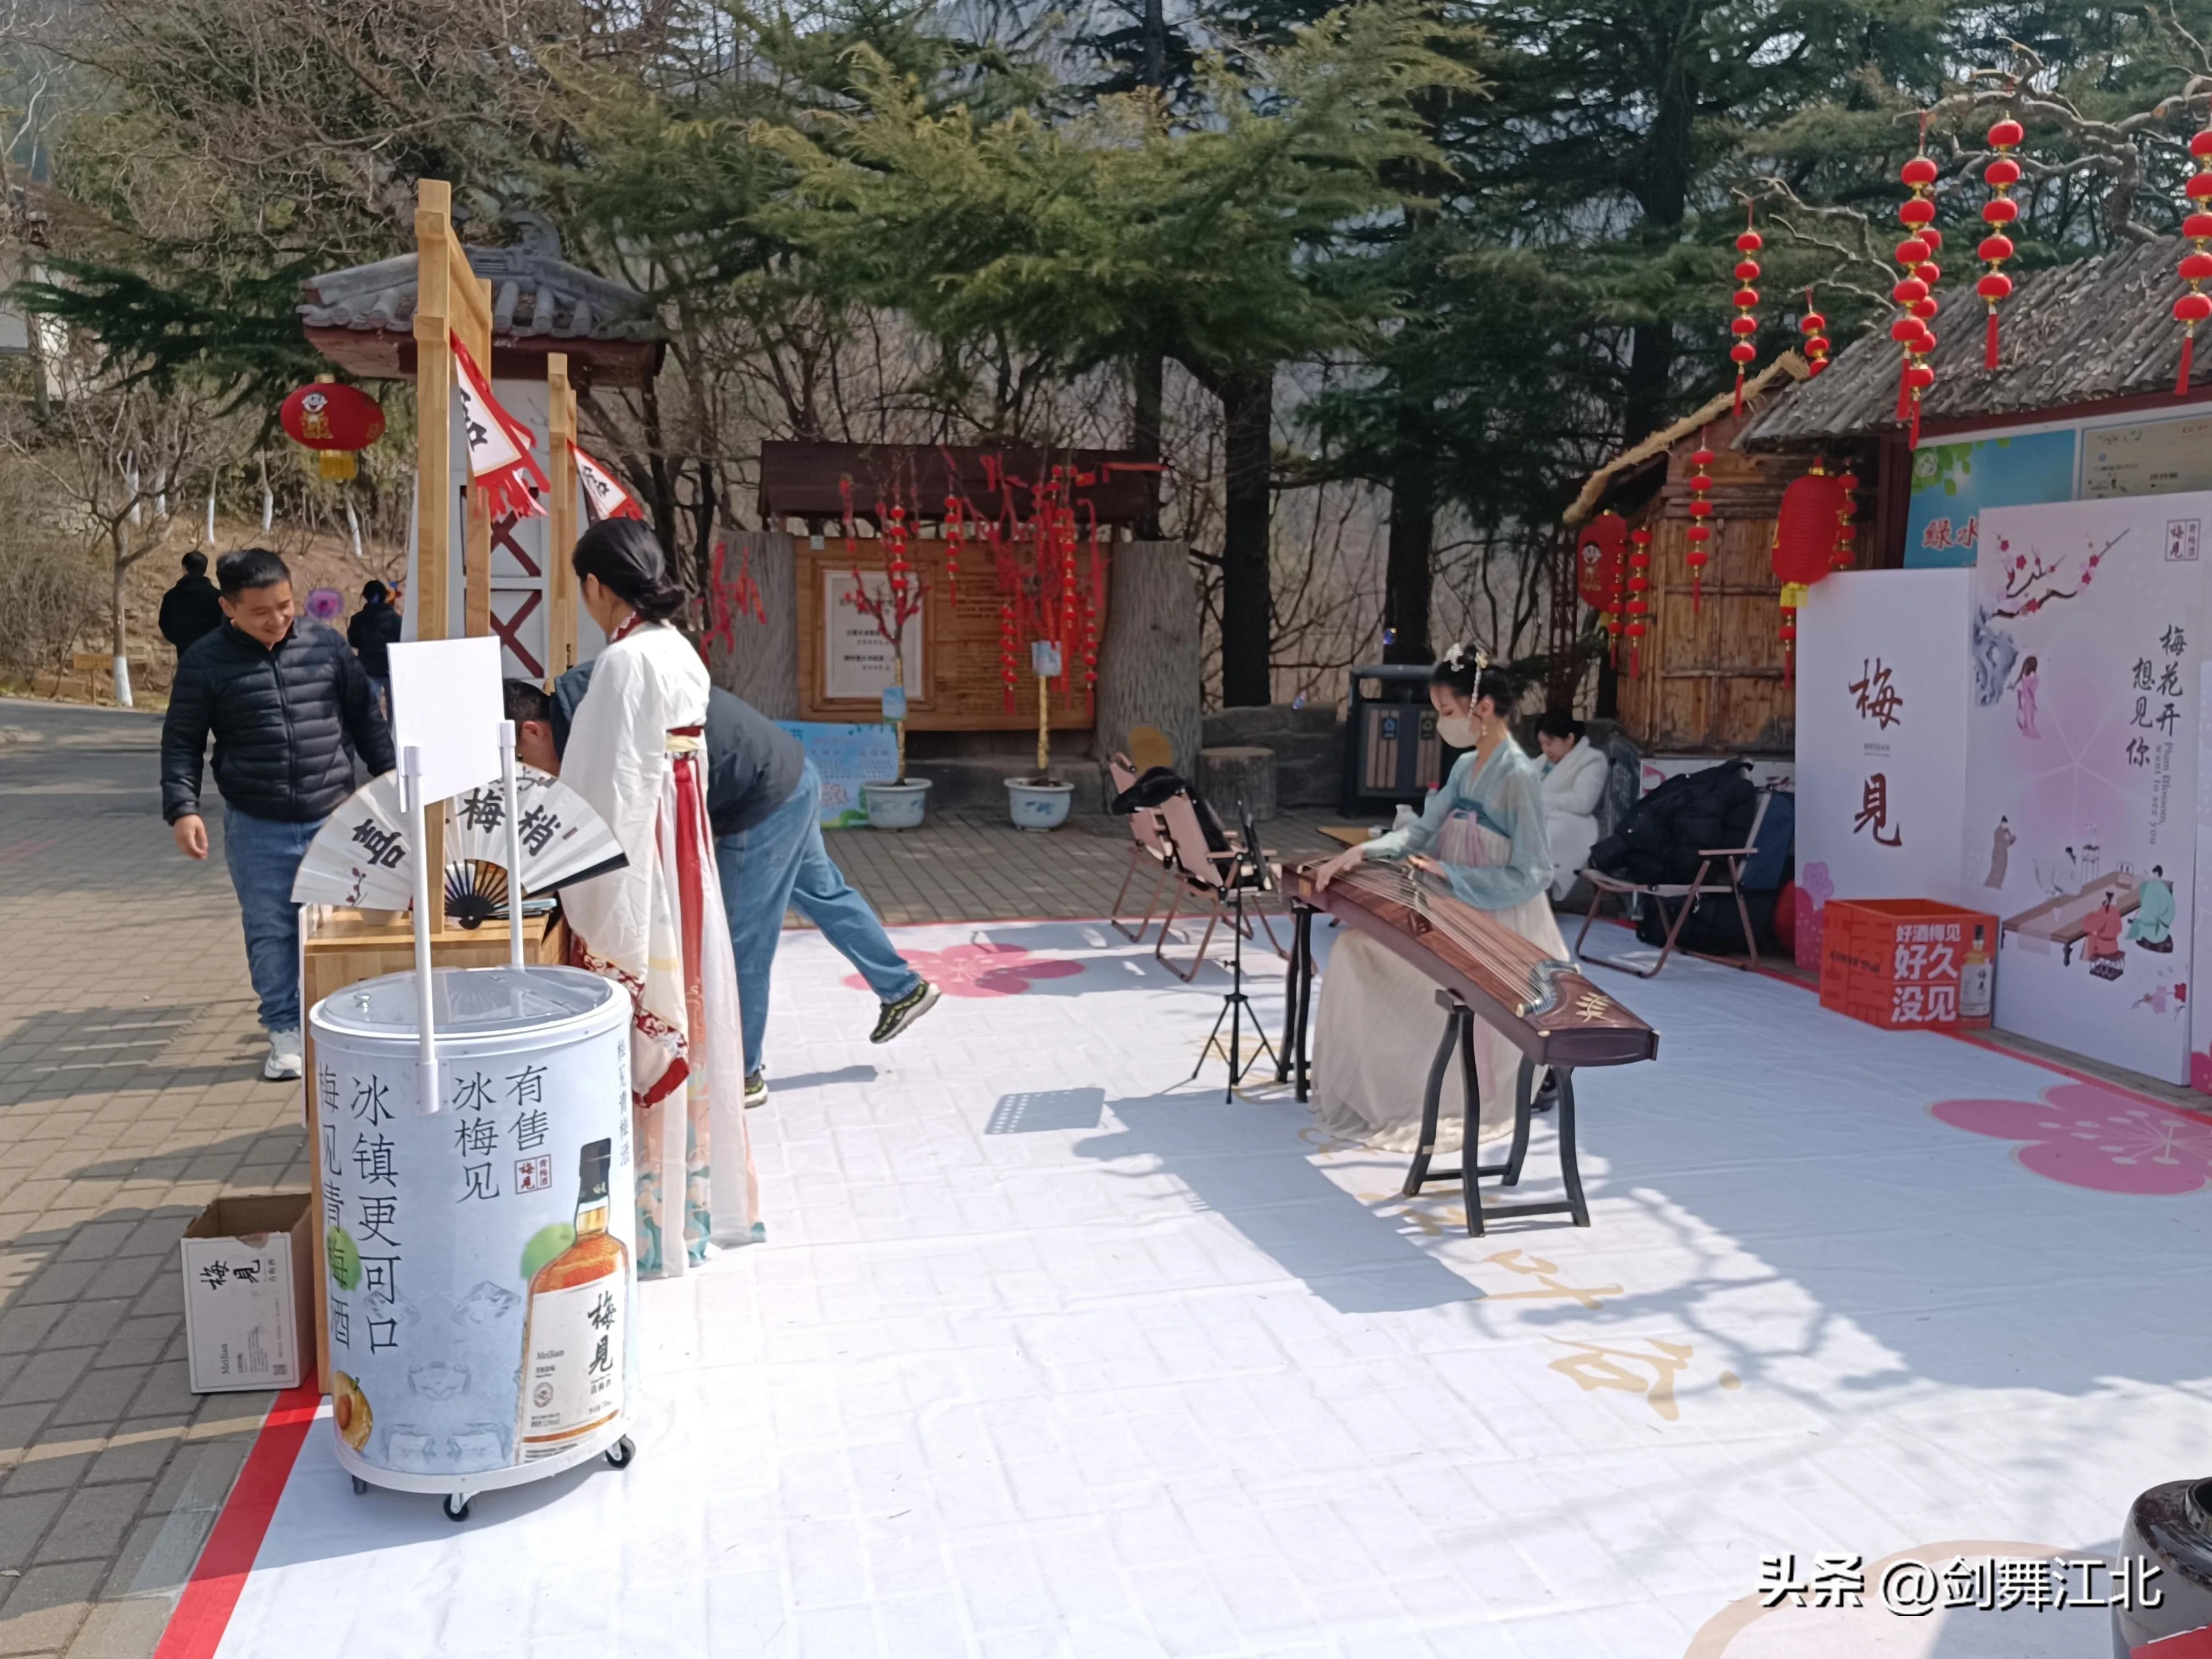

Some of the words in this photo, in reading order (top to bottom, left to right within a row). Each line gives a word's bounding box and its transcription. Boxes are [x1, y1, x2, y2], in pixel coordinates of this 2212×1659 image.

[2126, 657, 2155, 768] 想见你
[2155, 624, 2188, 737] 梅花开
[352, 787, 563, 869] 喜梅梢
[2148, 821, 2157, 845] you
[1891, 985, 1957, 1023] 没见
[1894, 943, 1958, 980] 好久
[452, 1071, 500, 1203] 冰梅见
[505, 1065, 549, 1151] 有售
[350, 1073, 402, 1355] 冰镇更可口
